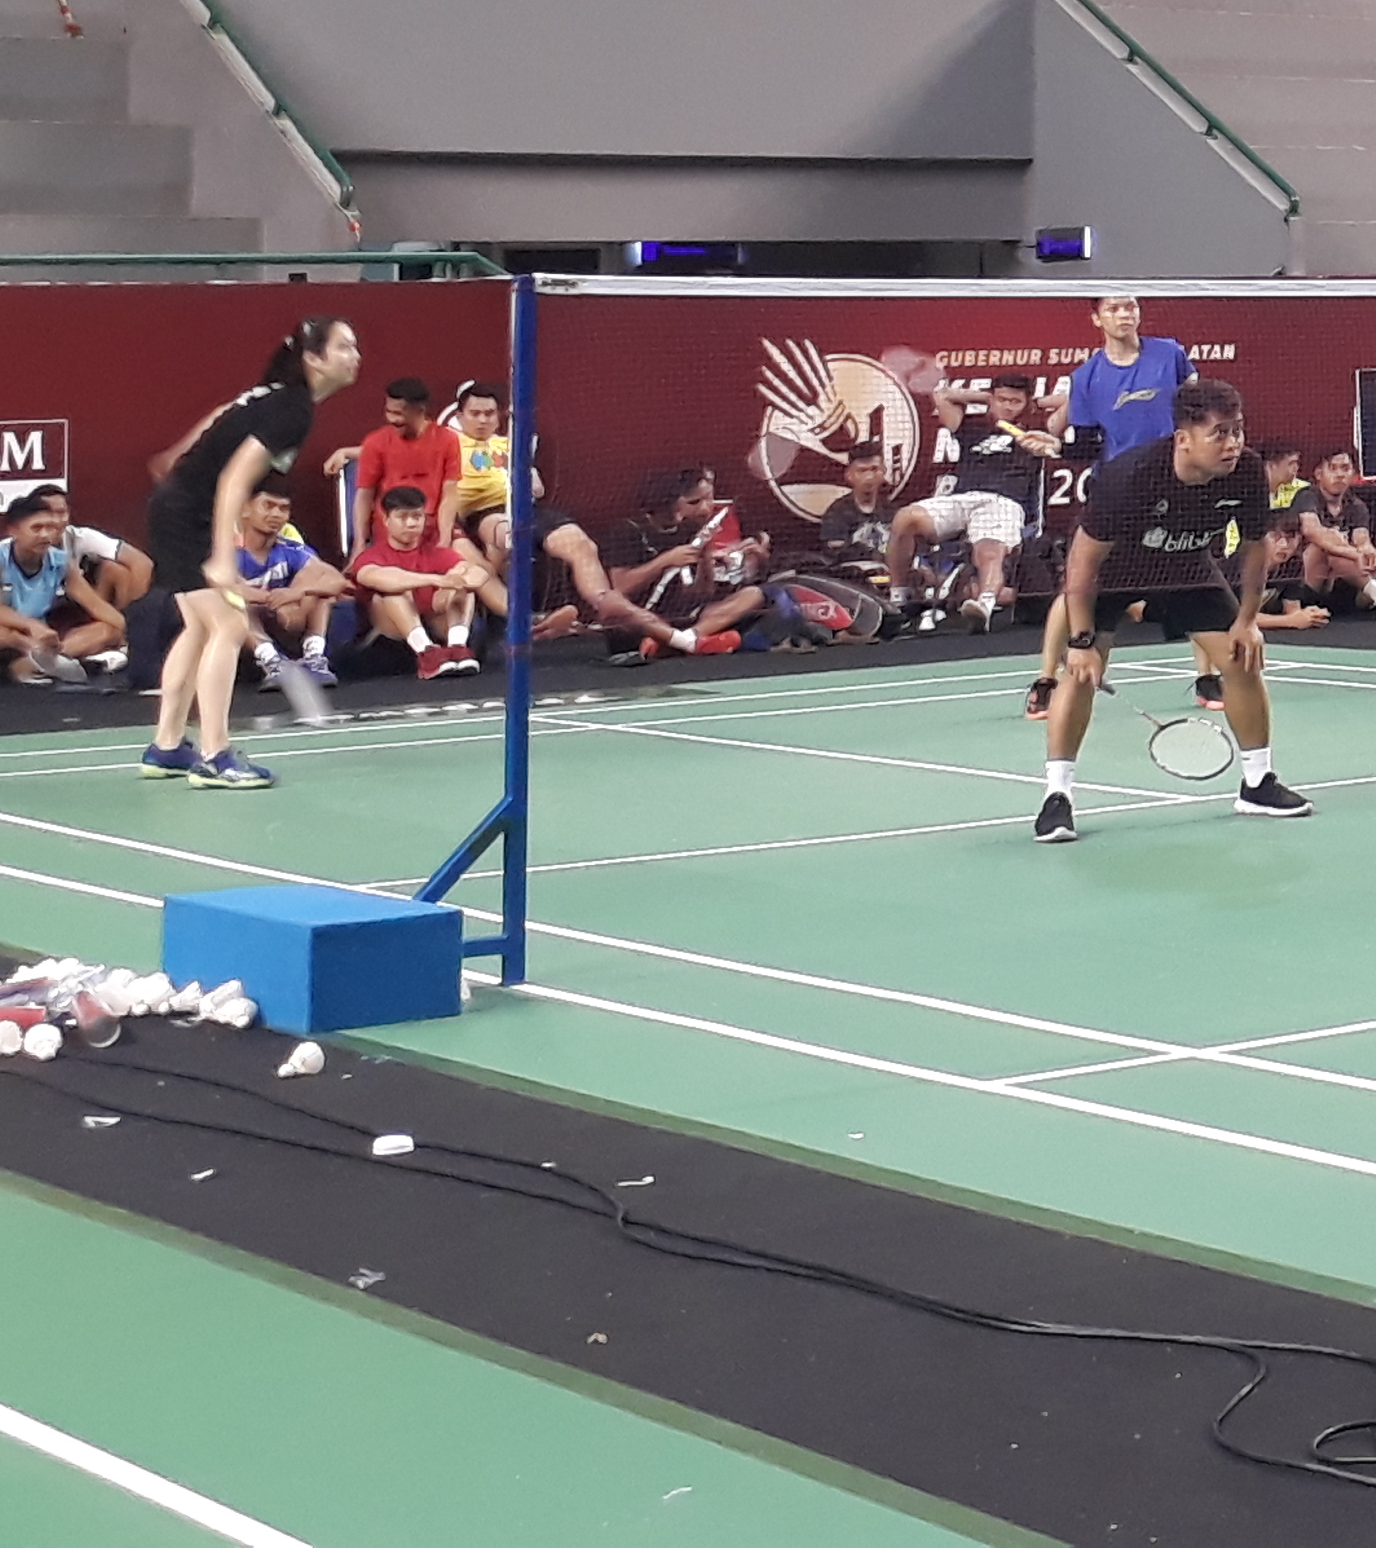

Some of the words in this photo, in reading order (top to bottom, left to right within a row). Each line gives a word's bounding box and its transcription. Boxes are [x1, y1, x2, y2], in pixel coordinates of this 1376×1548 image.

[935, 349, 1042, 368] GUBERNUR
[1048, 347, 1095, 365] SUM
[1187, 344, 1236, 361] ATAN
